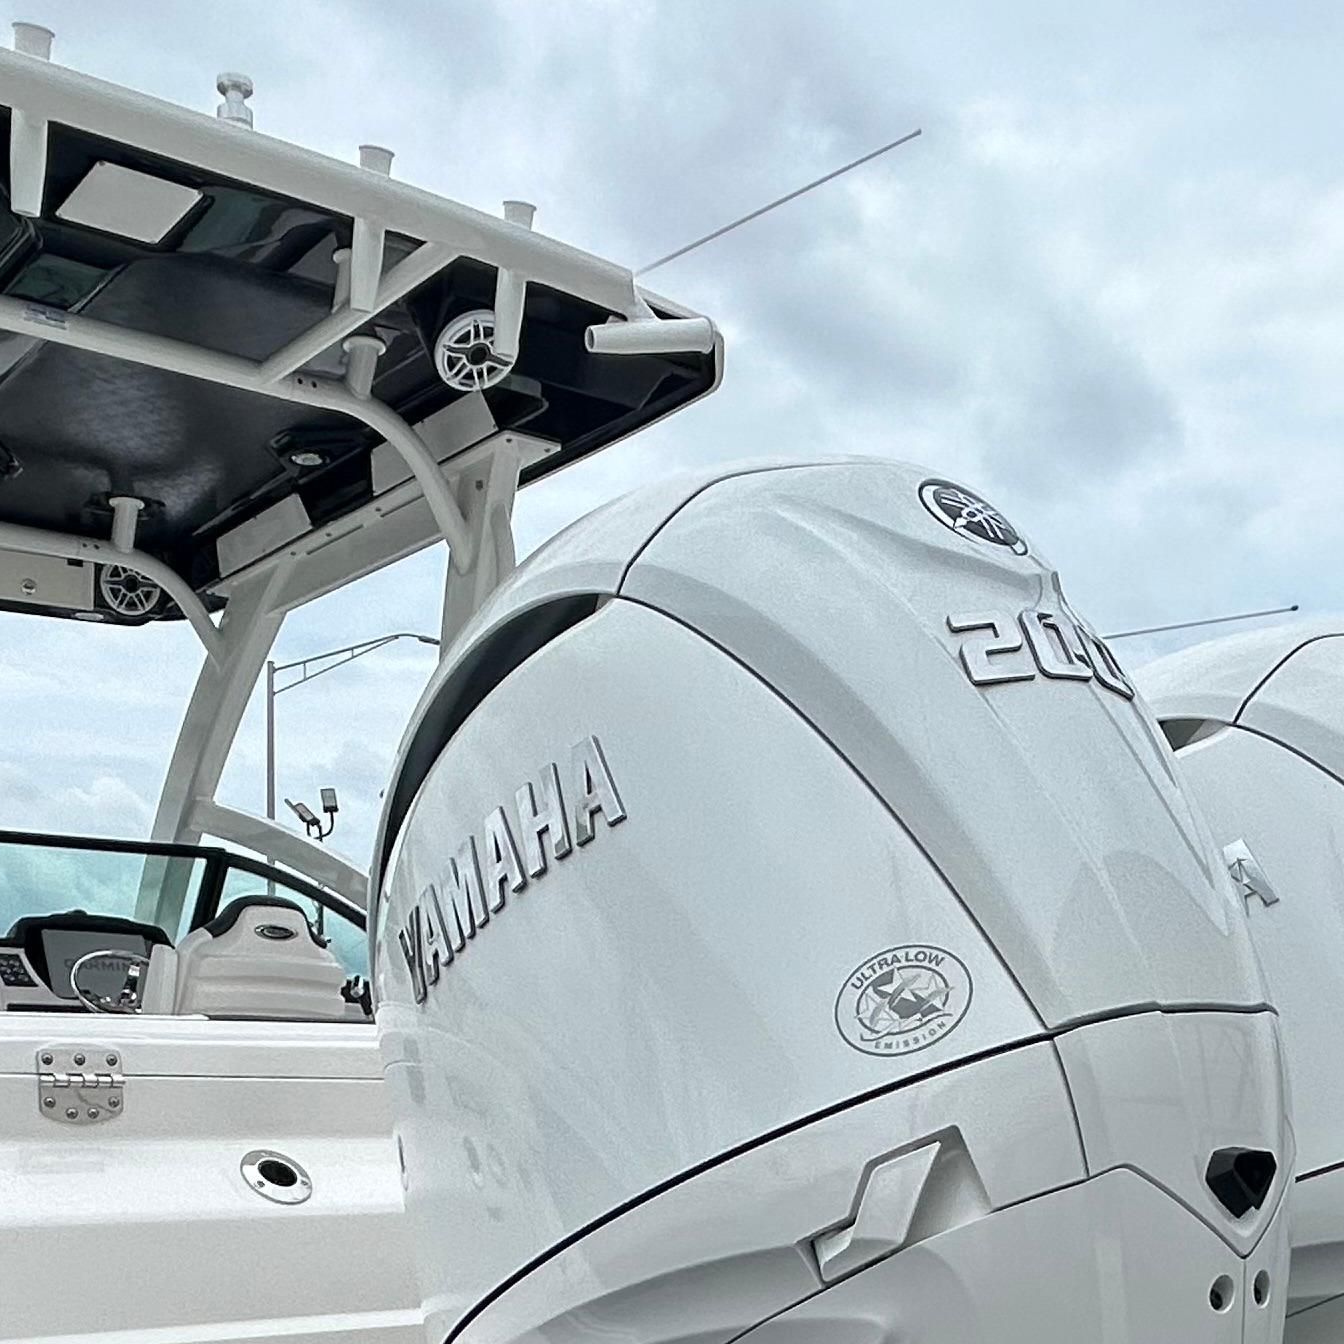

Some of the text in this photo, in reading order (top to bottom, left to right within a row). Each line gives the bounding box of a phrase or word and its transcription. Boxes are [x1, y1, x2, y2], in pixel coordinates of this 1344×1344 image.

[946, 609, 1135, 702] 200
[399, 734, 627, 1004] YAMAHA
[851, 950, 946, 990] ULTRA LOW
[874, 1020, 947, 1050] EMISSION
